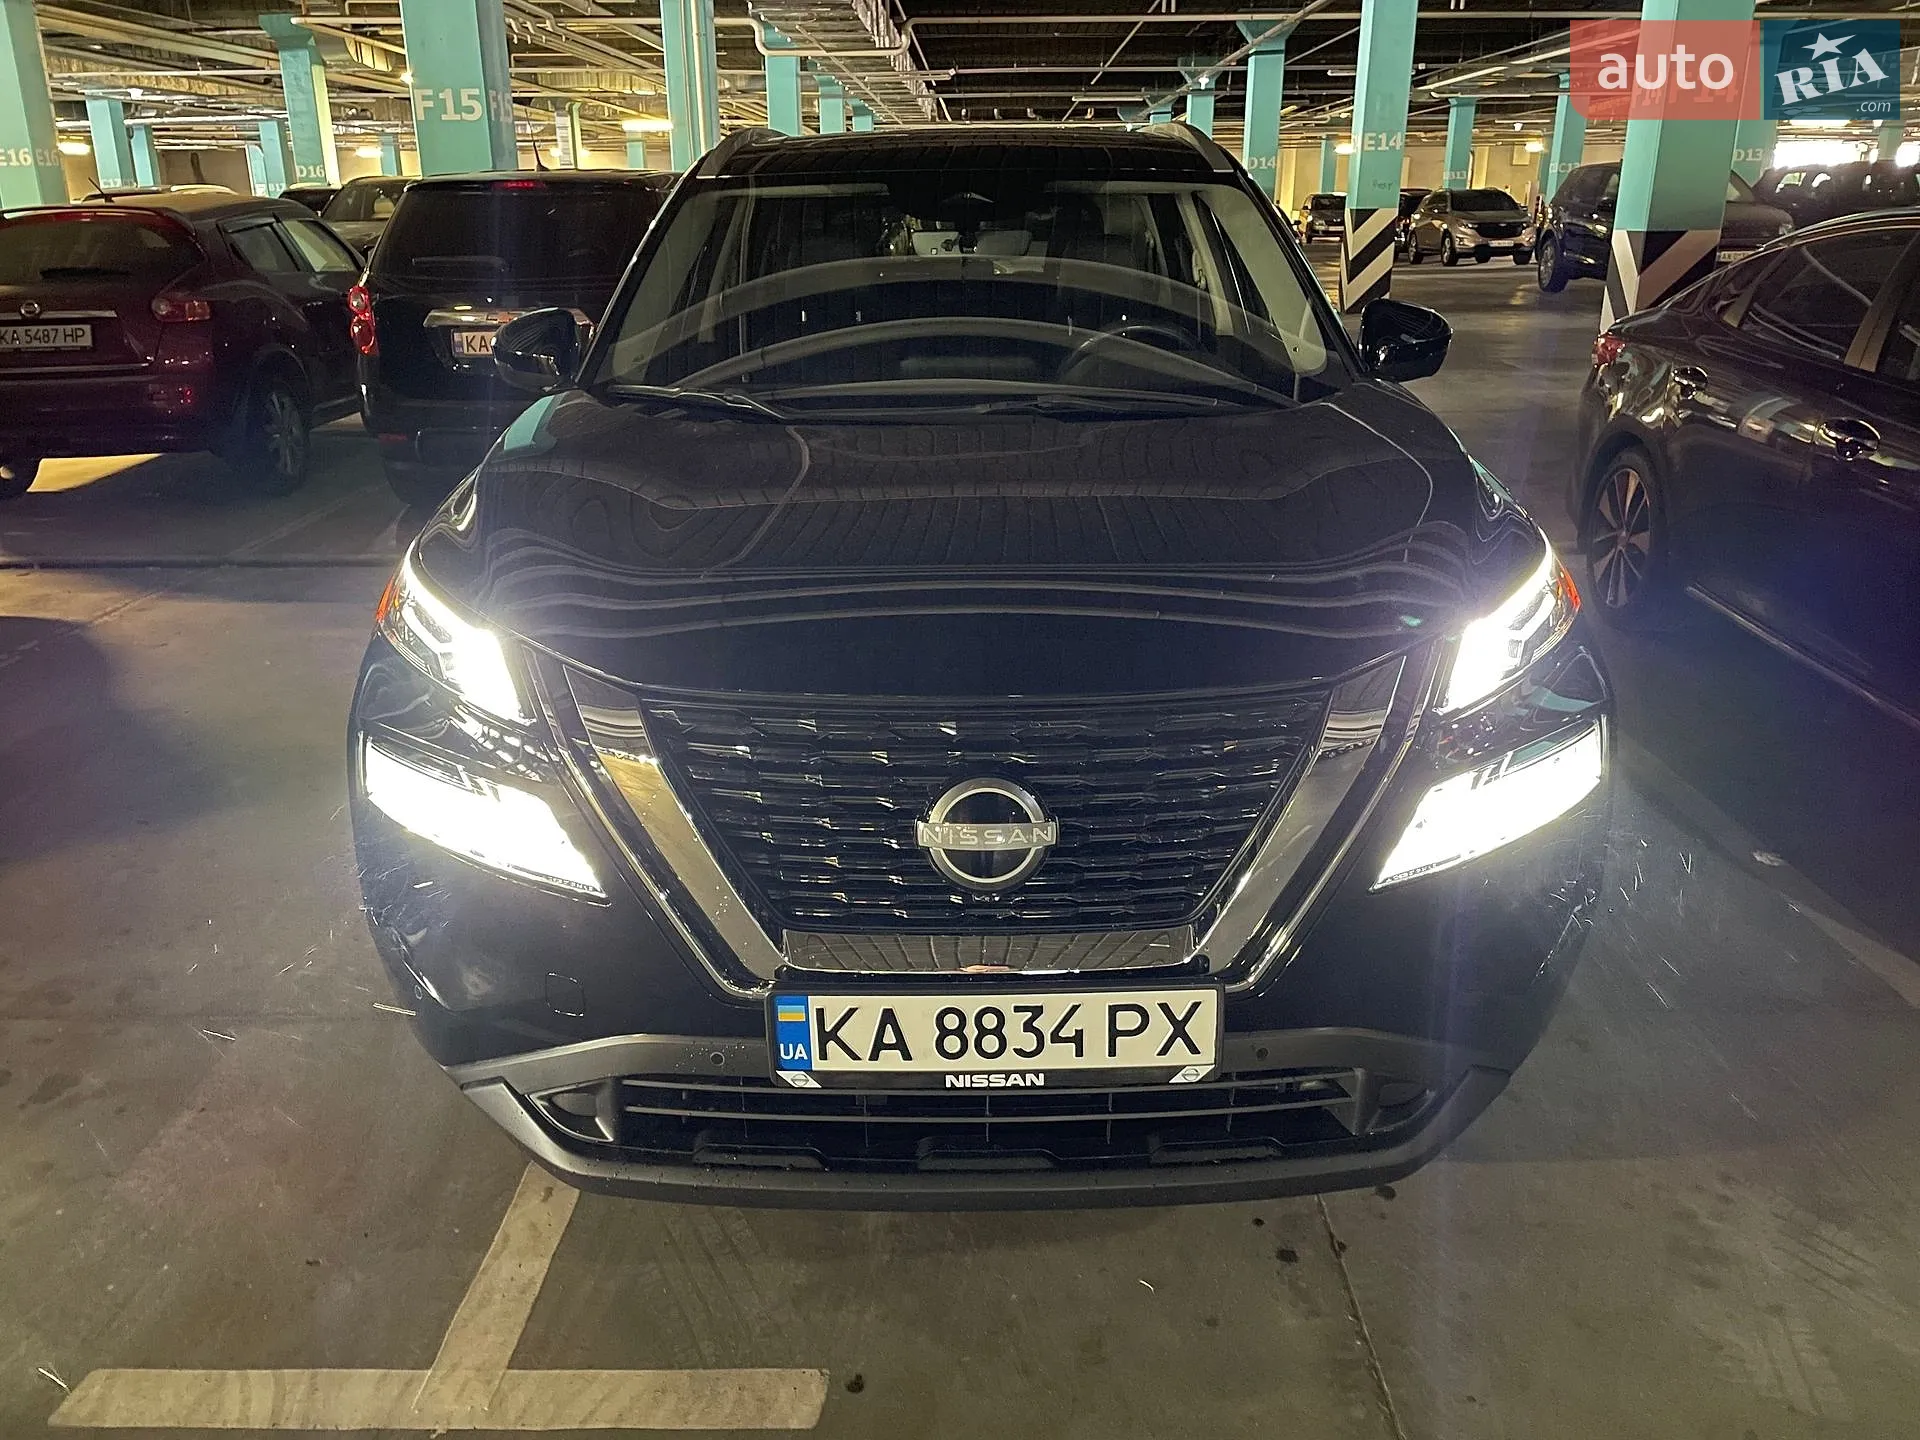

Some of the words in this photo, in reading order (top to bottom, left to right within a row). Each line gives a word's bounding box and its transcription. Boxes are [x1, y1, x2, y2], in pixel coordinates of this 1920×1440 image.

[413, 87, 483, 121] F15
[1363, 132, 1403, 151] E14
[1249, 156, 1277, 170] D14
[1735, 148, 1764, 161] D13
[297, 164, 325, 178] D16
[0, 329, 20, 345] KA
[24, 328, 58, 345] 5487
[62, 327, 86, 343] HP
[465, 335, 490, 353] KA
[923, 826, 1052, 846] NISSAN
[815, 1006, 914, 1063] KA
[934, 1003, 1085, 1061] 8834
[1107, 1001, 1203, 1059] PX
[779, 1043, 808, 1061] UA
[945, 1072, 1045, 1088] NISSAN
